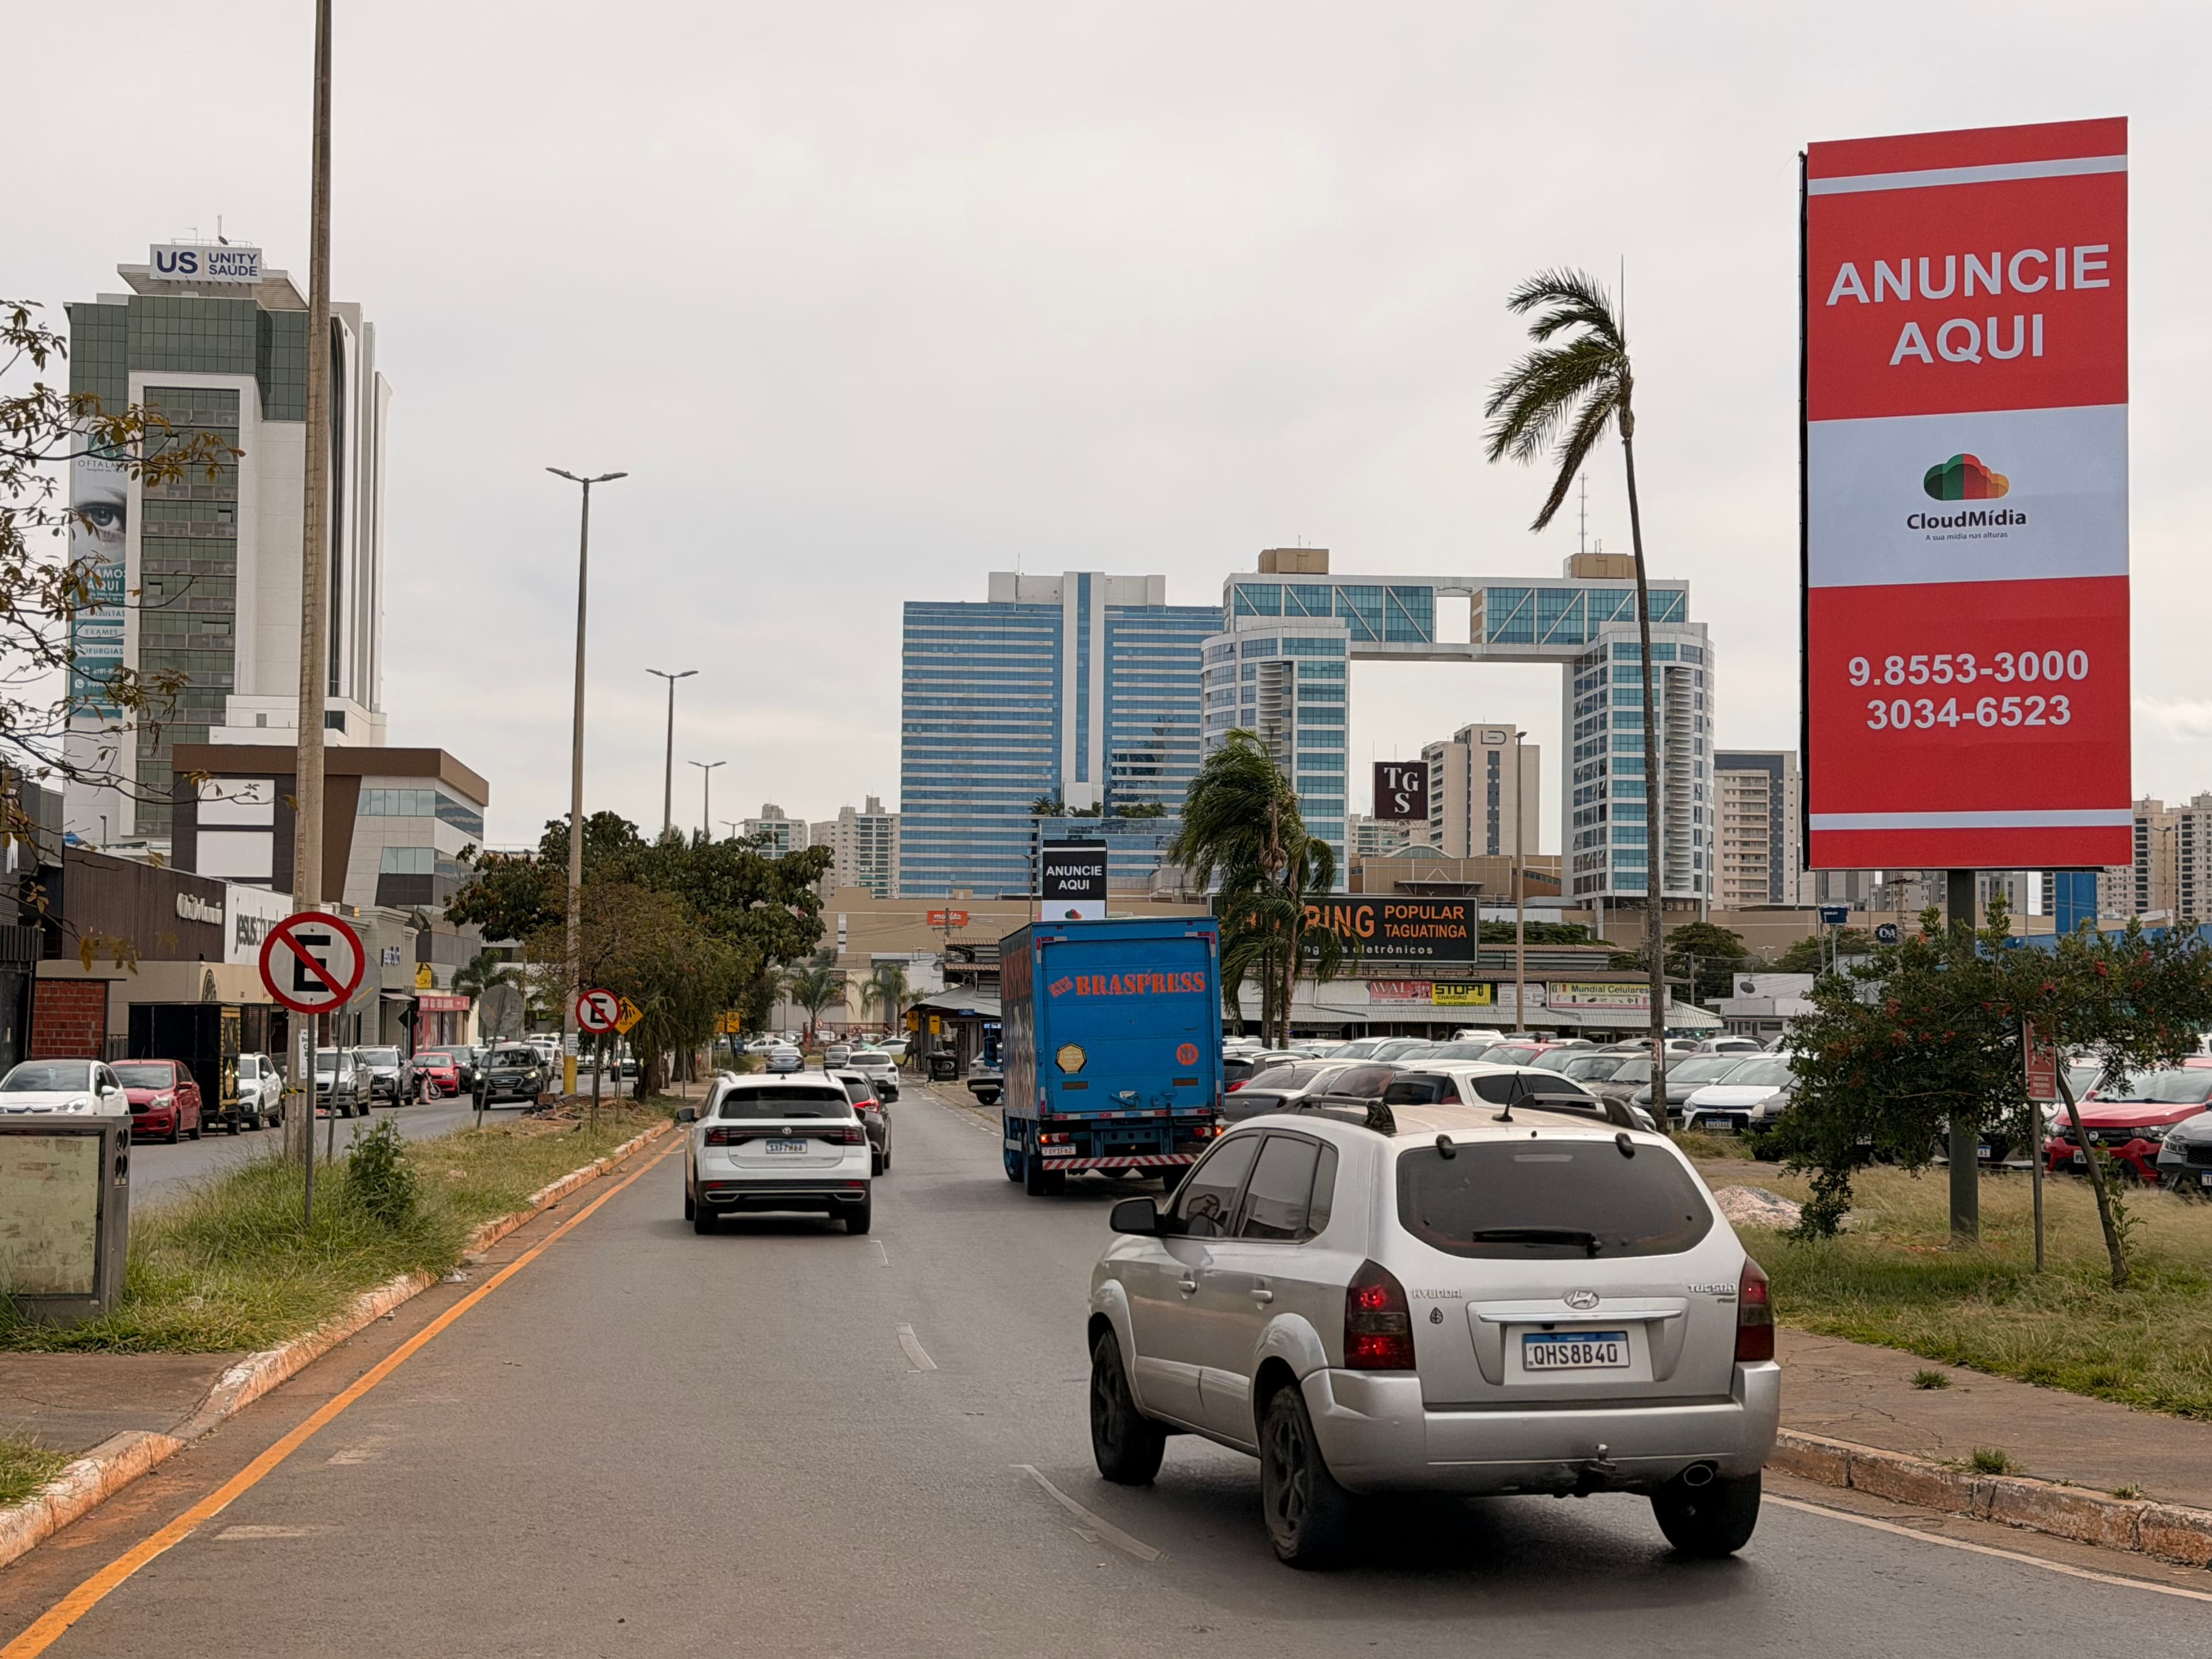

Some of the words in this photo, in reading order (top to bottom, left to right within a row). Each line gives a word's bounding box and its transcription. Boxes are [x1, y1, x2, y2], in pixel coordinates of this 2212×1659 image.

[157, 251, 198, 274] US
[208, 252, 257, 264] UNITY
[1826, 244, 2110, 306] ANUNCIE
[1889, 313, 2043, 366] AQUI
[1907, 509, 2027, 529] CloudMídia
[1849, 649, 2089, 686] 9.8553-3000
[1866, 695, 2071, 729] 3034-6523
[1046, 865, 1103, 877] ANUNCIE
[1058, 880, 1090, 890] AQUI
[1385, 905, 1464, 920] POPULAR
[1384, 924, 1467, 938] TAGUATINGA
[1075, 972, 1206, 995] BRASPRESS
[1571, 985, 1605, 993] Mundial
[1608, 986, 1649, 994] Celulares
[1534, 1343, 1618, 1365] QHS8B40
